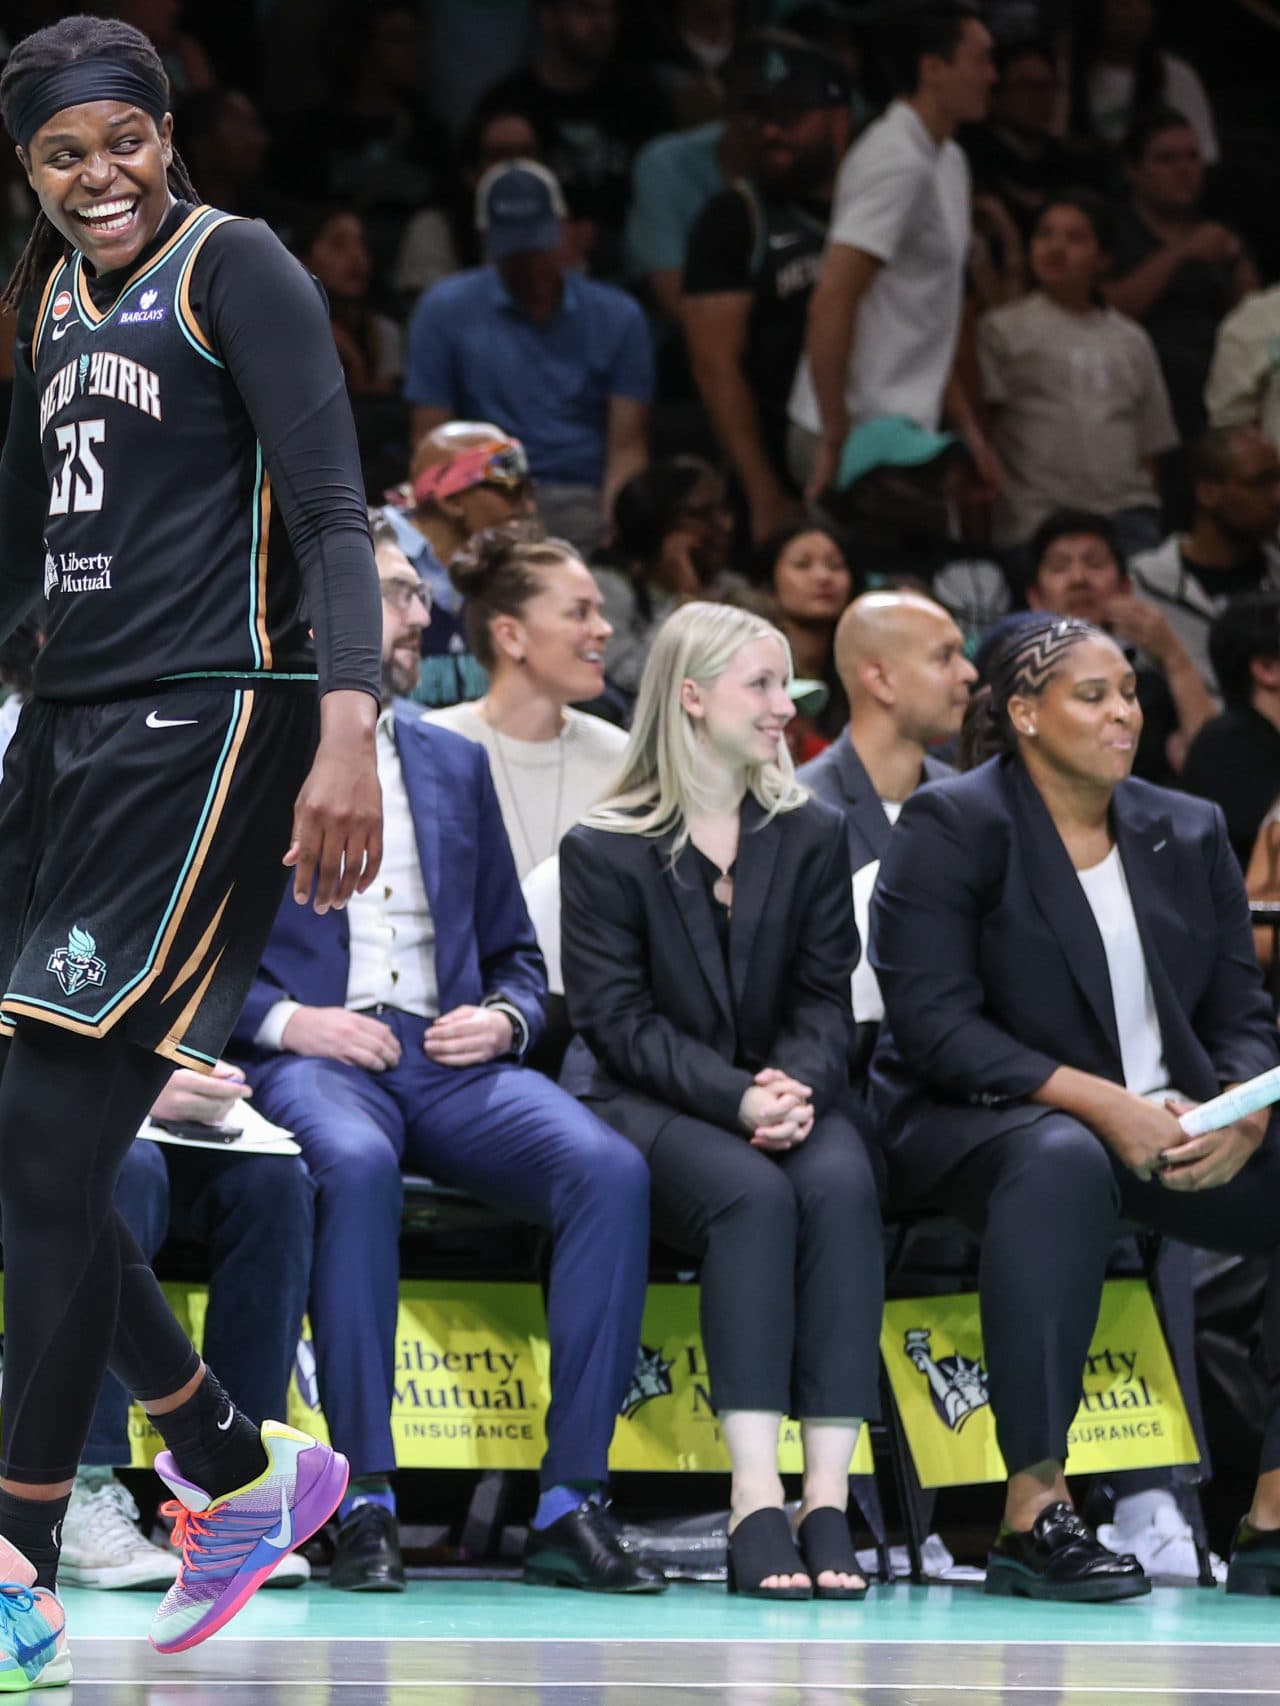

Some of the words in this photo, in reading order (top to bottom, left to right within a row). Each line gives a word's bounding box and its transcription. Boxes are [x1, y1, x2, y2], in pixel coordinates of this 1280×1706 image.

[120, 309, 164, 323] BARCLAYS
[40, 358, 78, 442] NEW
[88, 351, 161, 421] YORK
[49, 419, 106, 516] 35
[60, 552, 113, 577] Liberty
[60, 570, 113, 593] Mutual
[395, 1341, 520, 1386] iberty
[403, 1423, 534, 1440] INSURANCE
[1068, 1421, 1165, 1444] SURANCE
